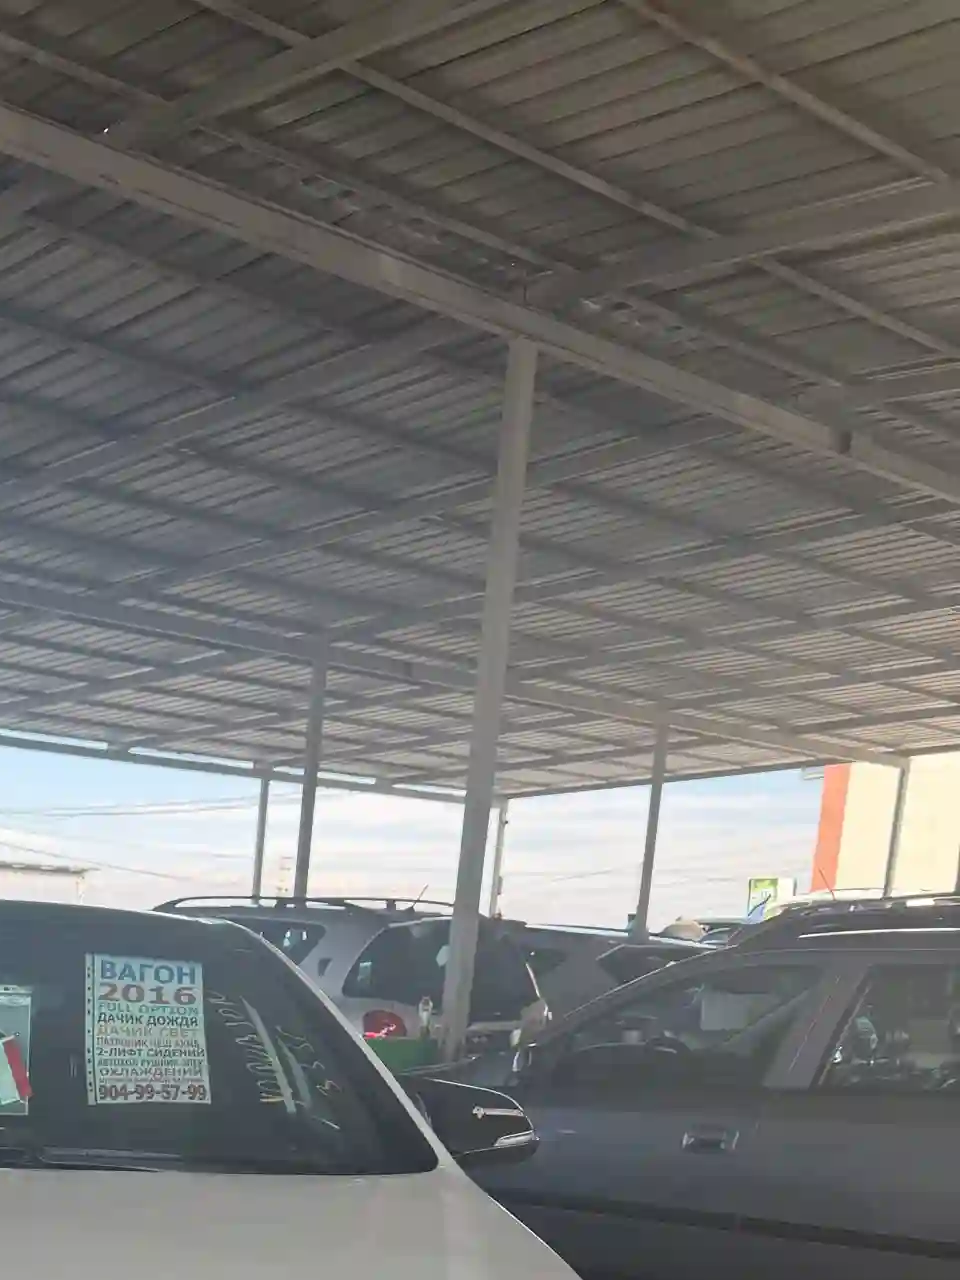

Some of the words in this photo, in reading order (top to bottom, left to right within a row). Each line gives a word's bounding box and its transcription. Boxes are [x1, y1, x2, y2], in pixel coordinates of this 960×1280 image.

[100, 960, 196, 984] ВАГОН
[98, 983, 197, 1005] 2016
[98, 1002, 135, 1013] FULL
[138, 1005, 199, 1015] OPTION
[97, 1012, 144, 1025] ДАЧИК
[146, 1015, 199, 1027] ДОЖДЯ
[96, 1048, 143, 1058] 2-ЛИФТ
